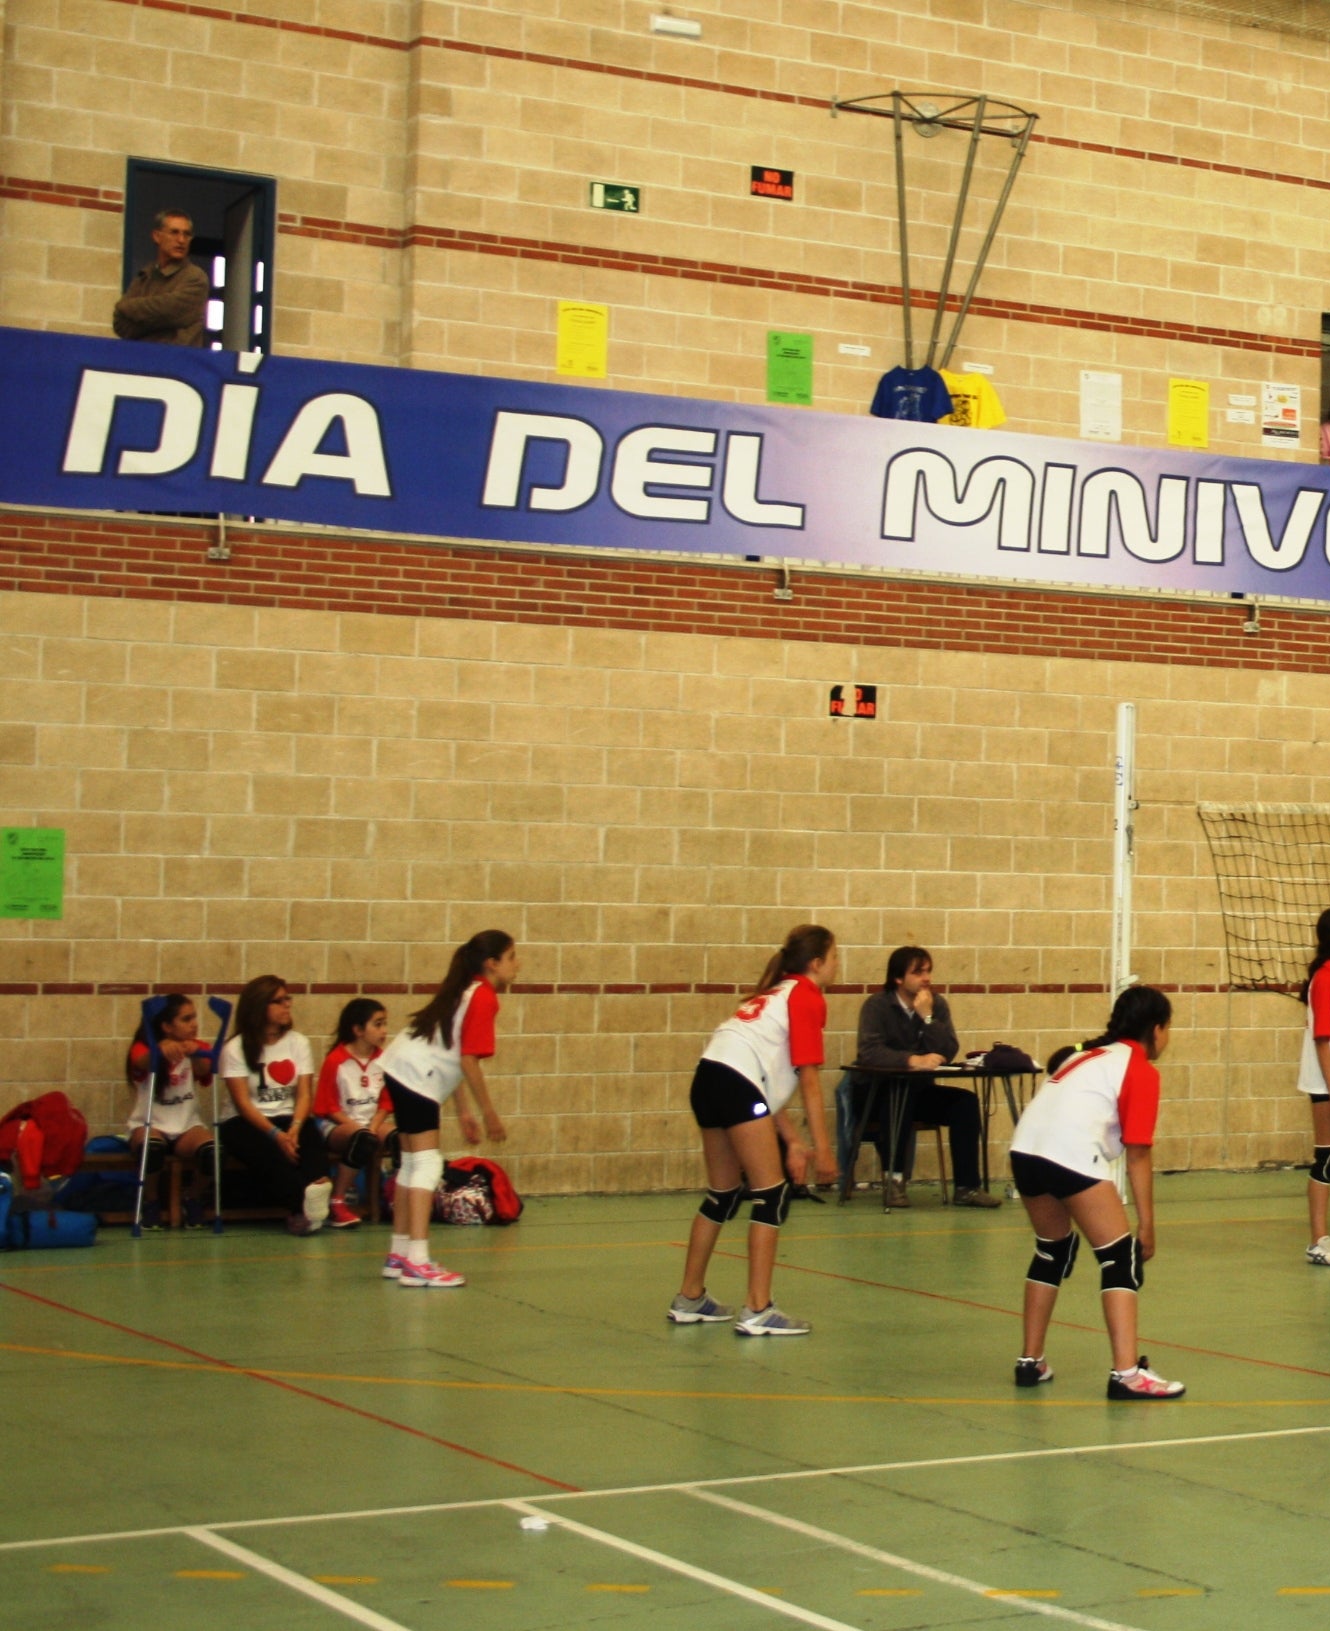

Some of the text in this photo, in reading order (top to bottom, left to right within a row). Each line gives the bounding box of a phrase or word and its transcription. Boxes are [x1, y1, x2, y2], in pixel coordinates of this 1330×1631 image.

[763, 170, 780, 184] NO
[751, 180, 792, 198] FUMAR
[62, 348, 392, 499] DÍA
[481, 410, 806, 530] DEL
